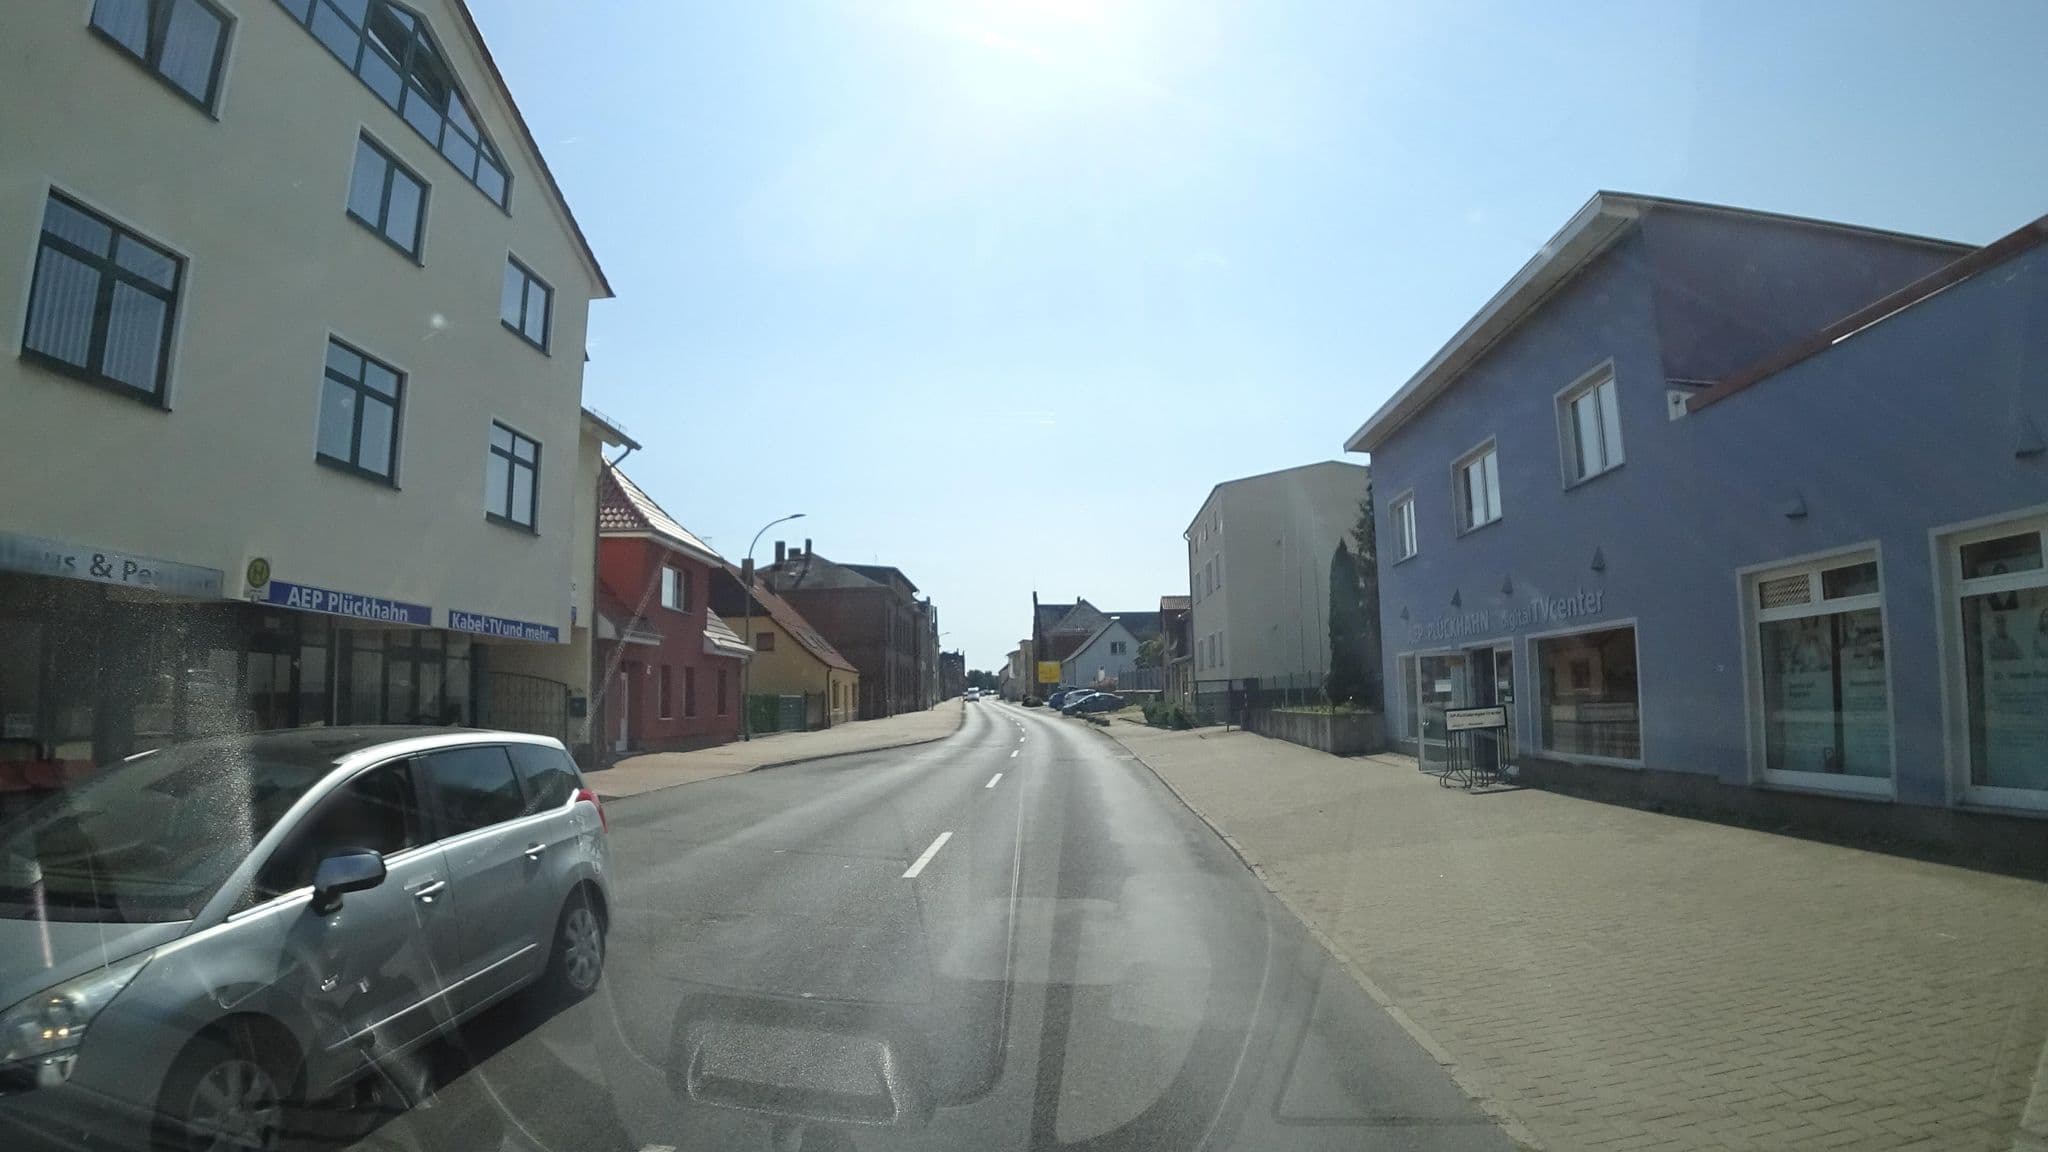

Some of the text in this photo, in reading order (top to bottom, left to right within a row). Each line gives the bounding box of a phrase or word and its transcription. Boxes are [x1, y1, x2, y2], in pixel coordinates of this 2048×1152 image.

[89, 553, 113, 579] &
[286, 586, 408, 622] AEP Plückhahn
